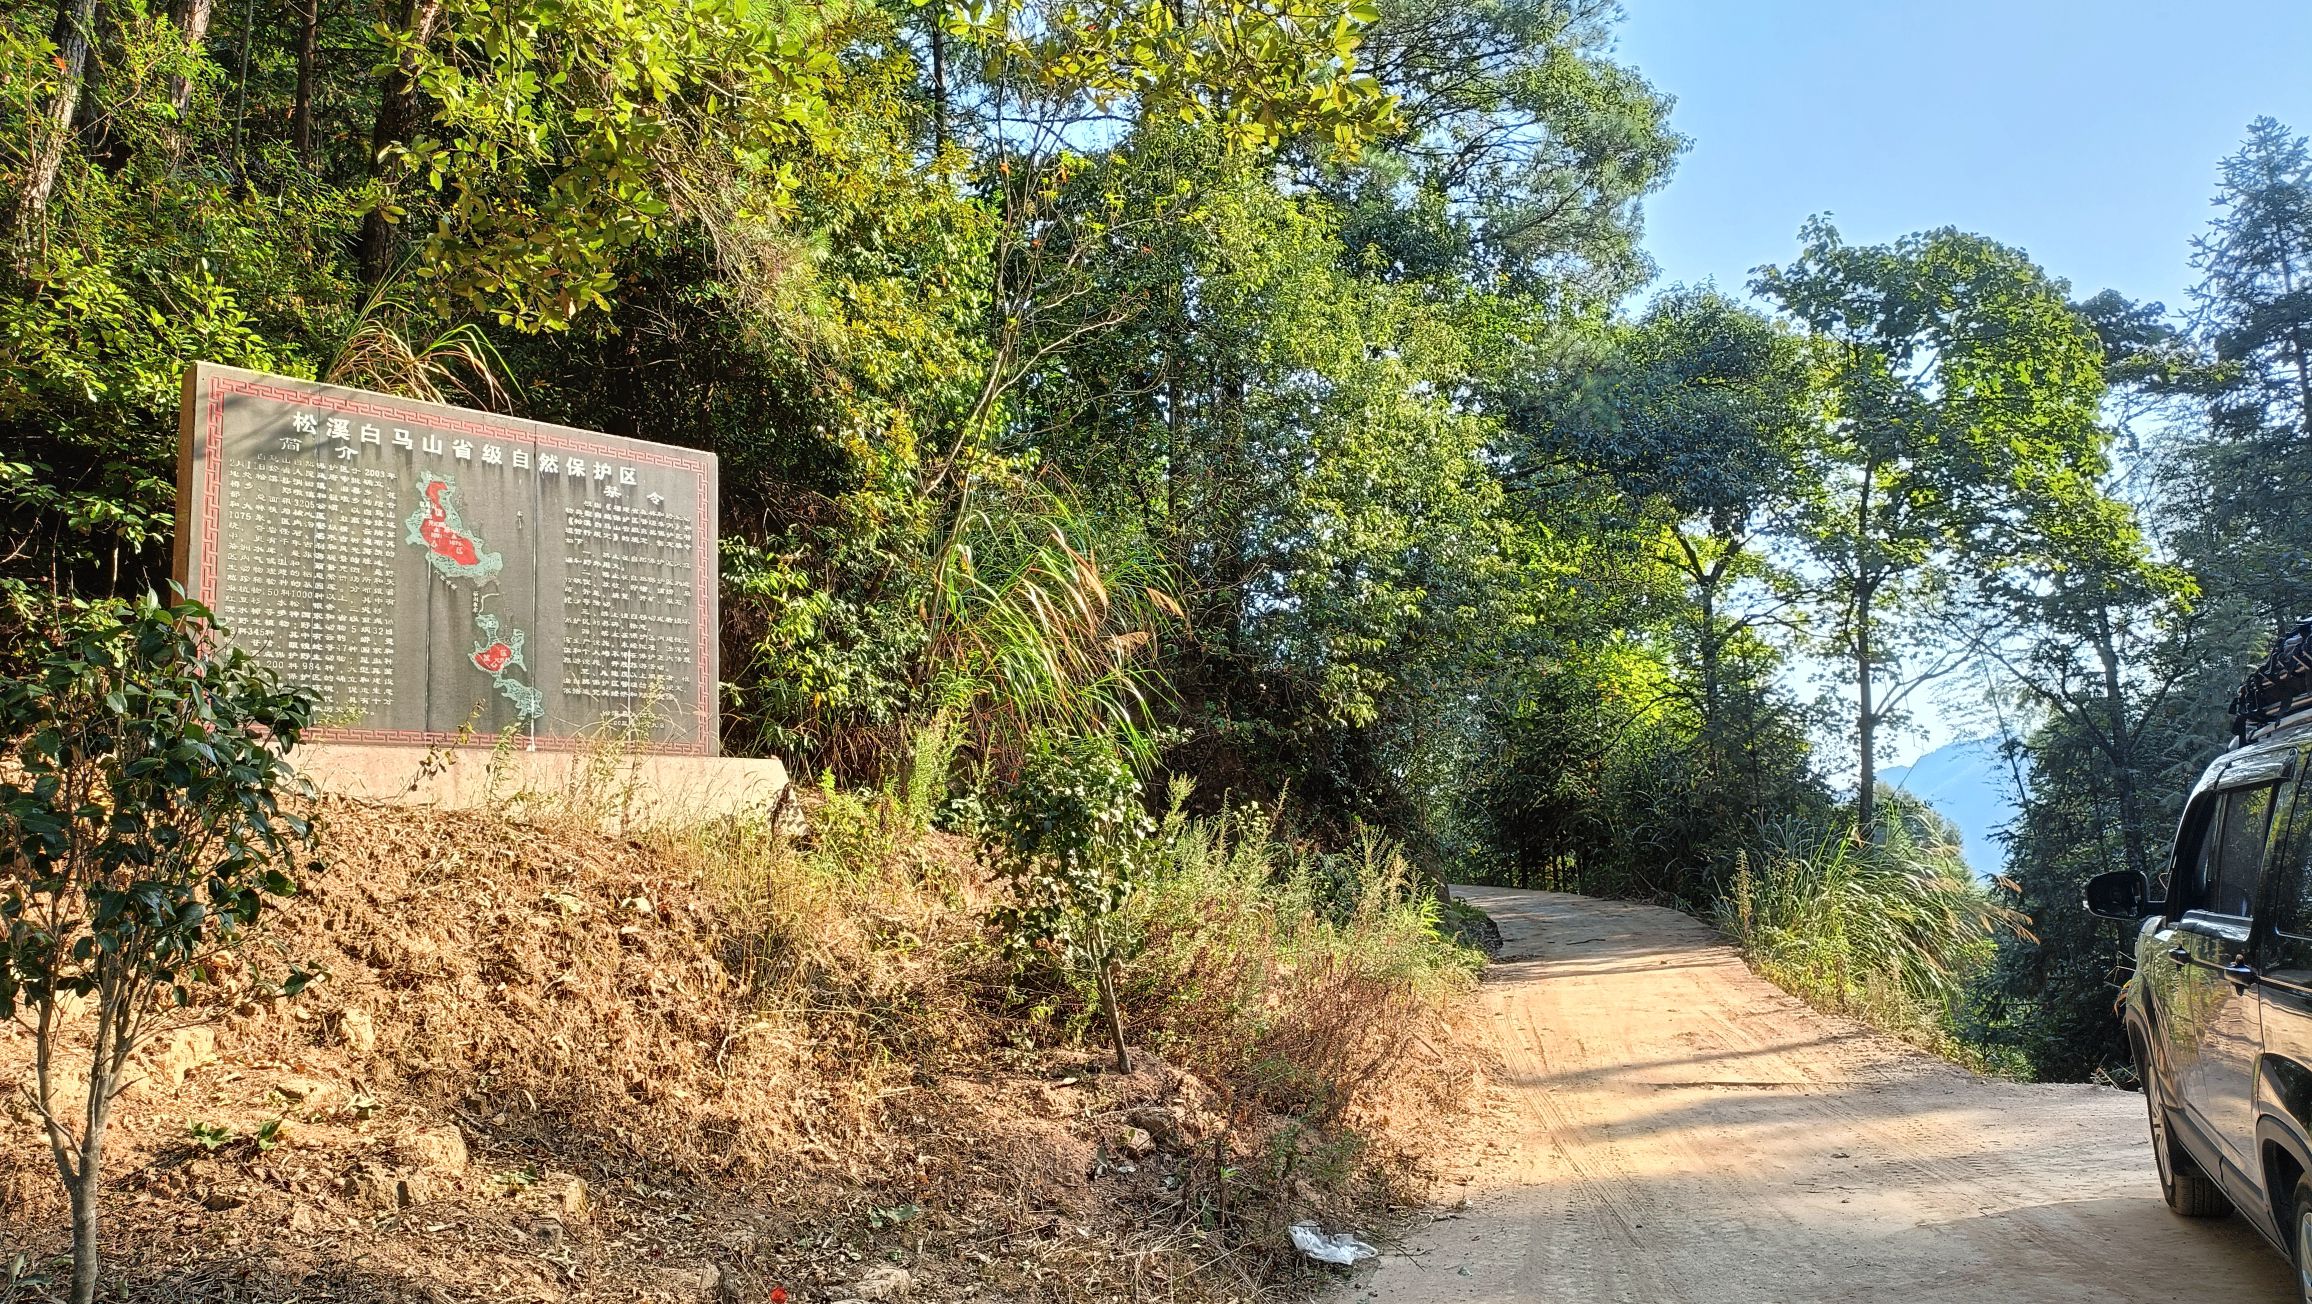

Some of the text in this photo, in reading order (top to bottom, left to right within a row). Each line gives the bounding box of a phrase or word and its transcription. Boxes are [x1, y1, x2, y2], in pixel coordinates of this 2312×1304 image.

[293, 411, 637, 486] 松溪白马山省级自然保护区
[603, 485, 665, 505] 禁令
